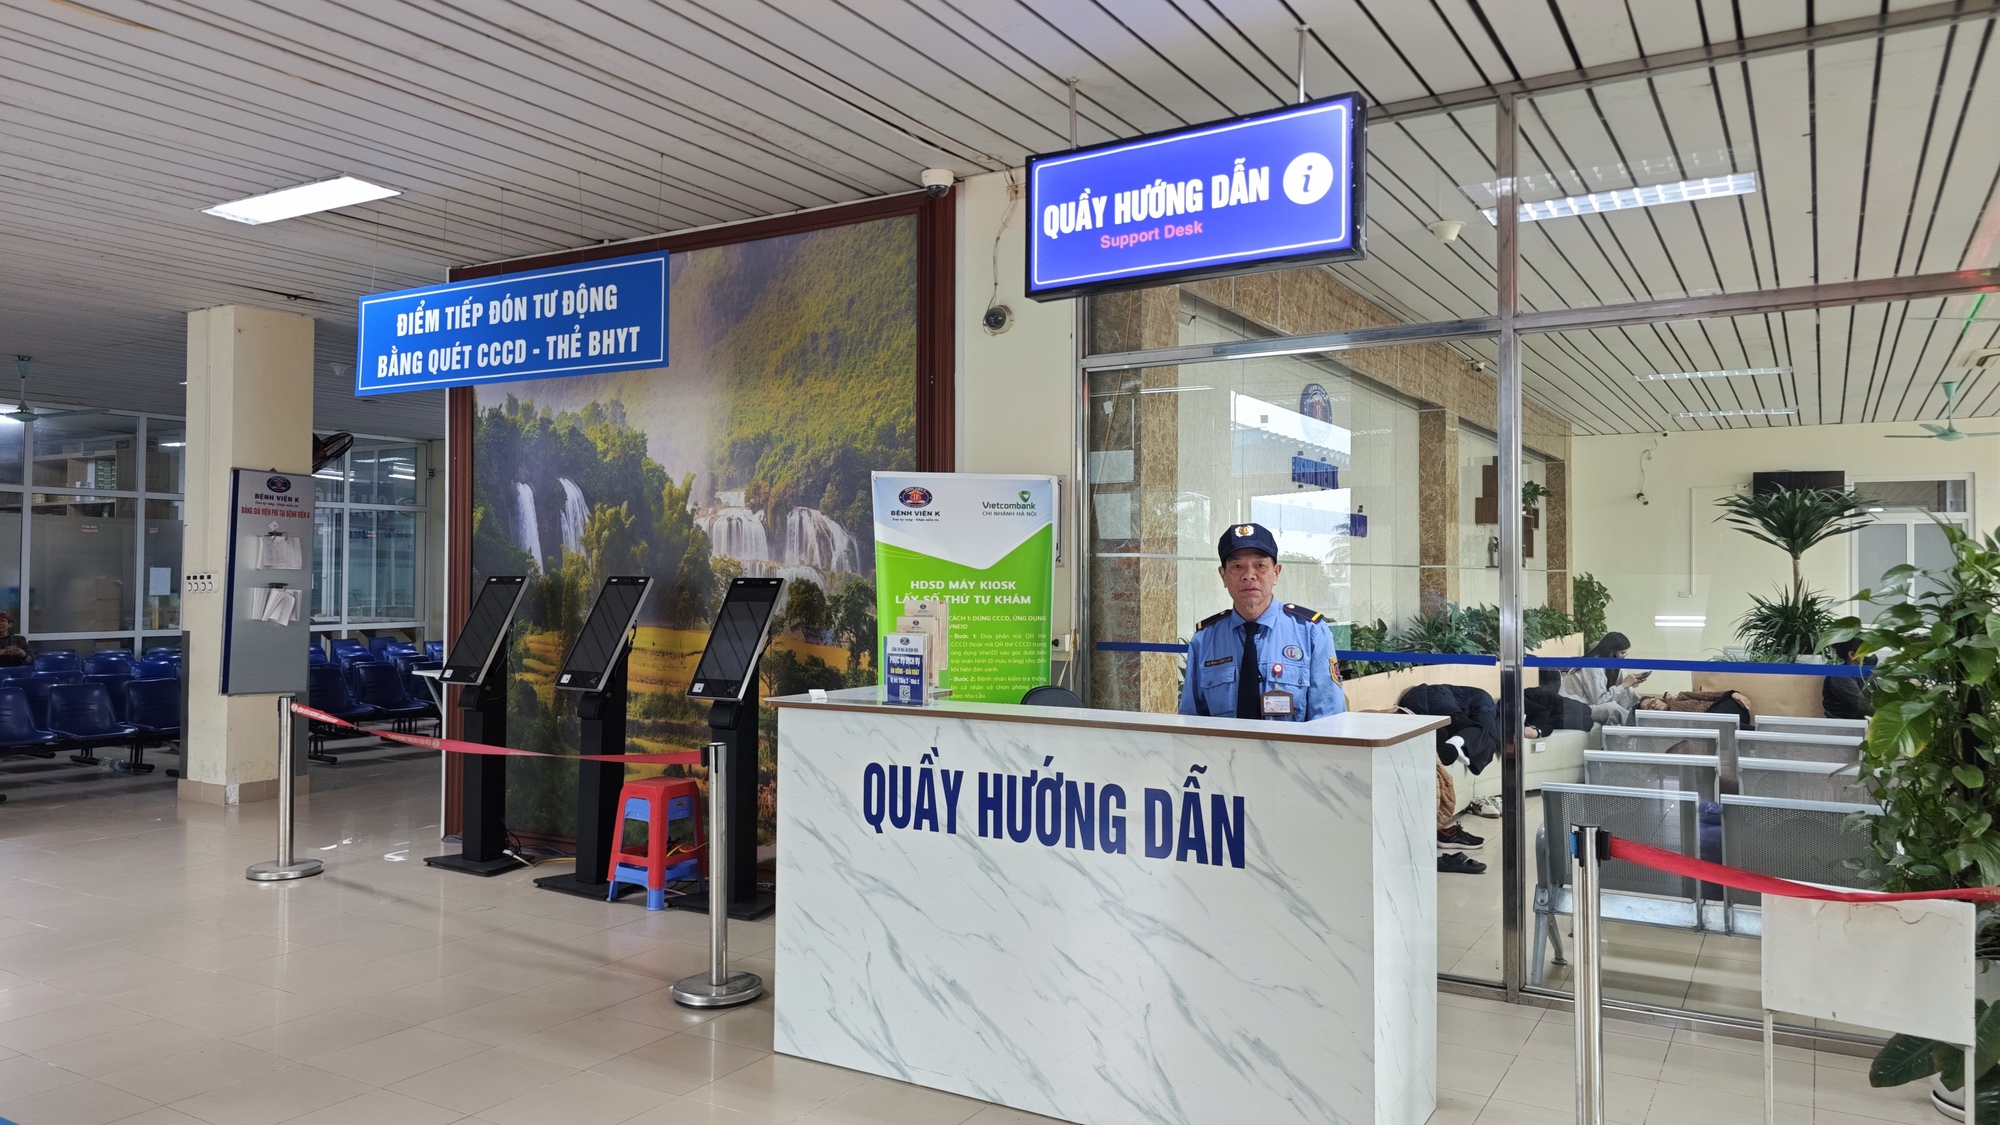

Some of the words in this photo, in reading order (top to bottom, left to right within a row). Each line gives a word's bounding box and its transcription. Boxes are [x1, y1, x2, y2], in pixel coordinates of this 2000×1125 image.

[1044, 188, 1108, 239] QUẦY
[1114, 179, 1203, 225] HƯỚNG
[1211, 158, 1270, 208] DẪN
[1100, 228, 1160, 249] Support
[1164, 220, 1203, 238] Desk
[397, 300, 440, 336] ĐIỂM
[445, 296, 484, 329] TIẾP
[488, 294, 527, 325] ĐÓN
[533, 290, 558, 318] TƯ
[562, 283, 618, 319] ĐỘNG
[377, 345, 422, 378] BẰNG
[428, 342, 472, 374] QUÉT
[477, 339, 526, 368] CCCD
[546, 324, 582, 360] THẺ
[588, 326, 640, 356] BHYT
[255, 493, 274, 502] BỆNH
[982, 502, 1036, 510] Vietcombank
[896, 592, 918, 603] LẤY
[923, 592, 943, 602] SỐ
[943, 593, 970, 604] THỨ
[973, 595, 988, 605] TỰ
[995, 594, 1031, 604] KHÁM
[910, 580, 944, 589] HDSD
[949, 579, 975, 589] MÁY
[980, 581, 1016, 589] KIOSK
[862, 746, 964, 834] QUẦY
[978, 755, 1127, 855] HƯỚNG
[1144, 764, 1245, 869] DẪN
